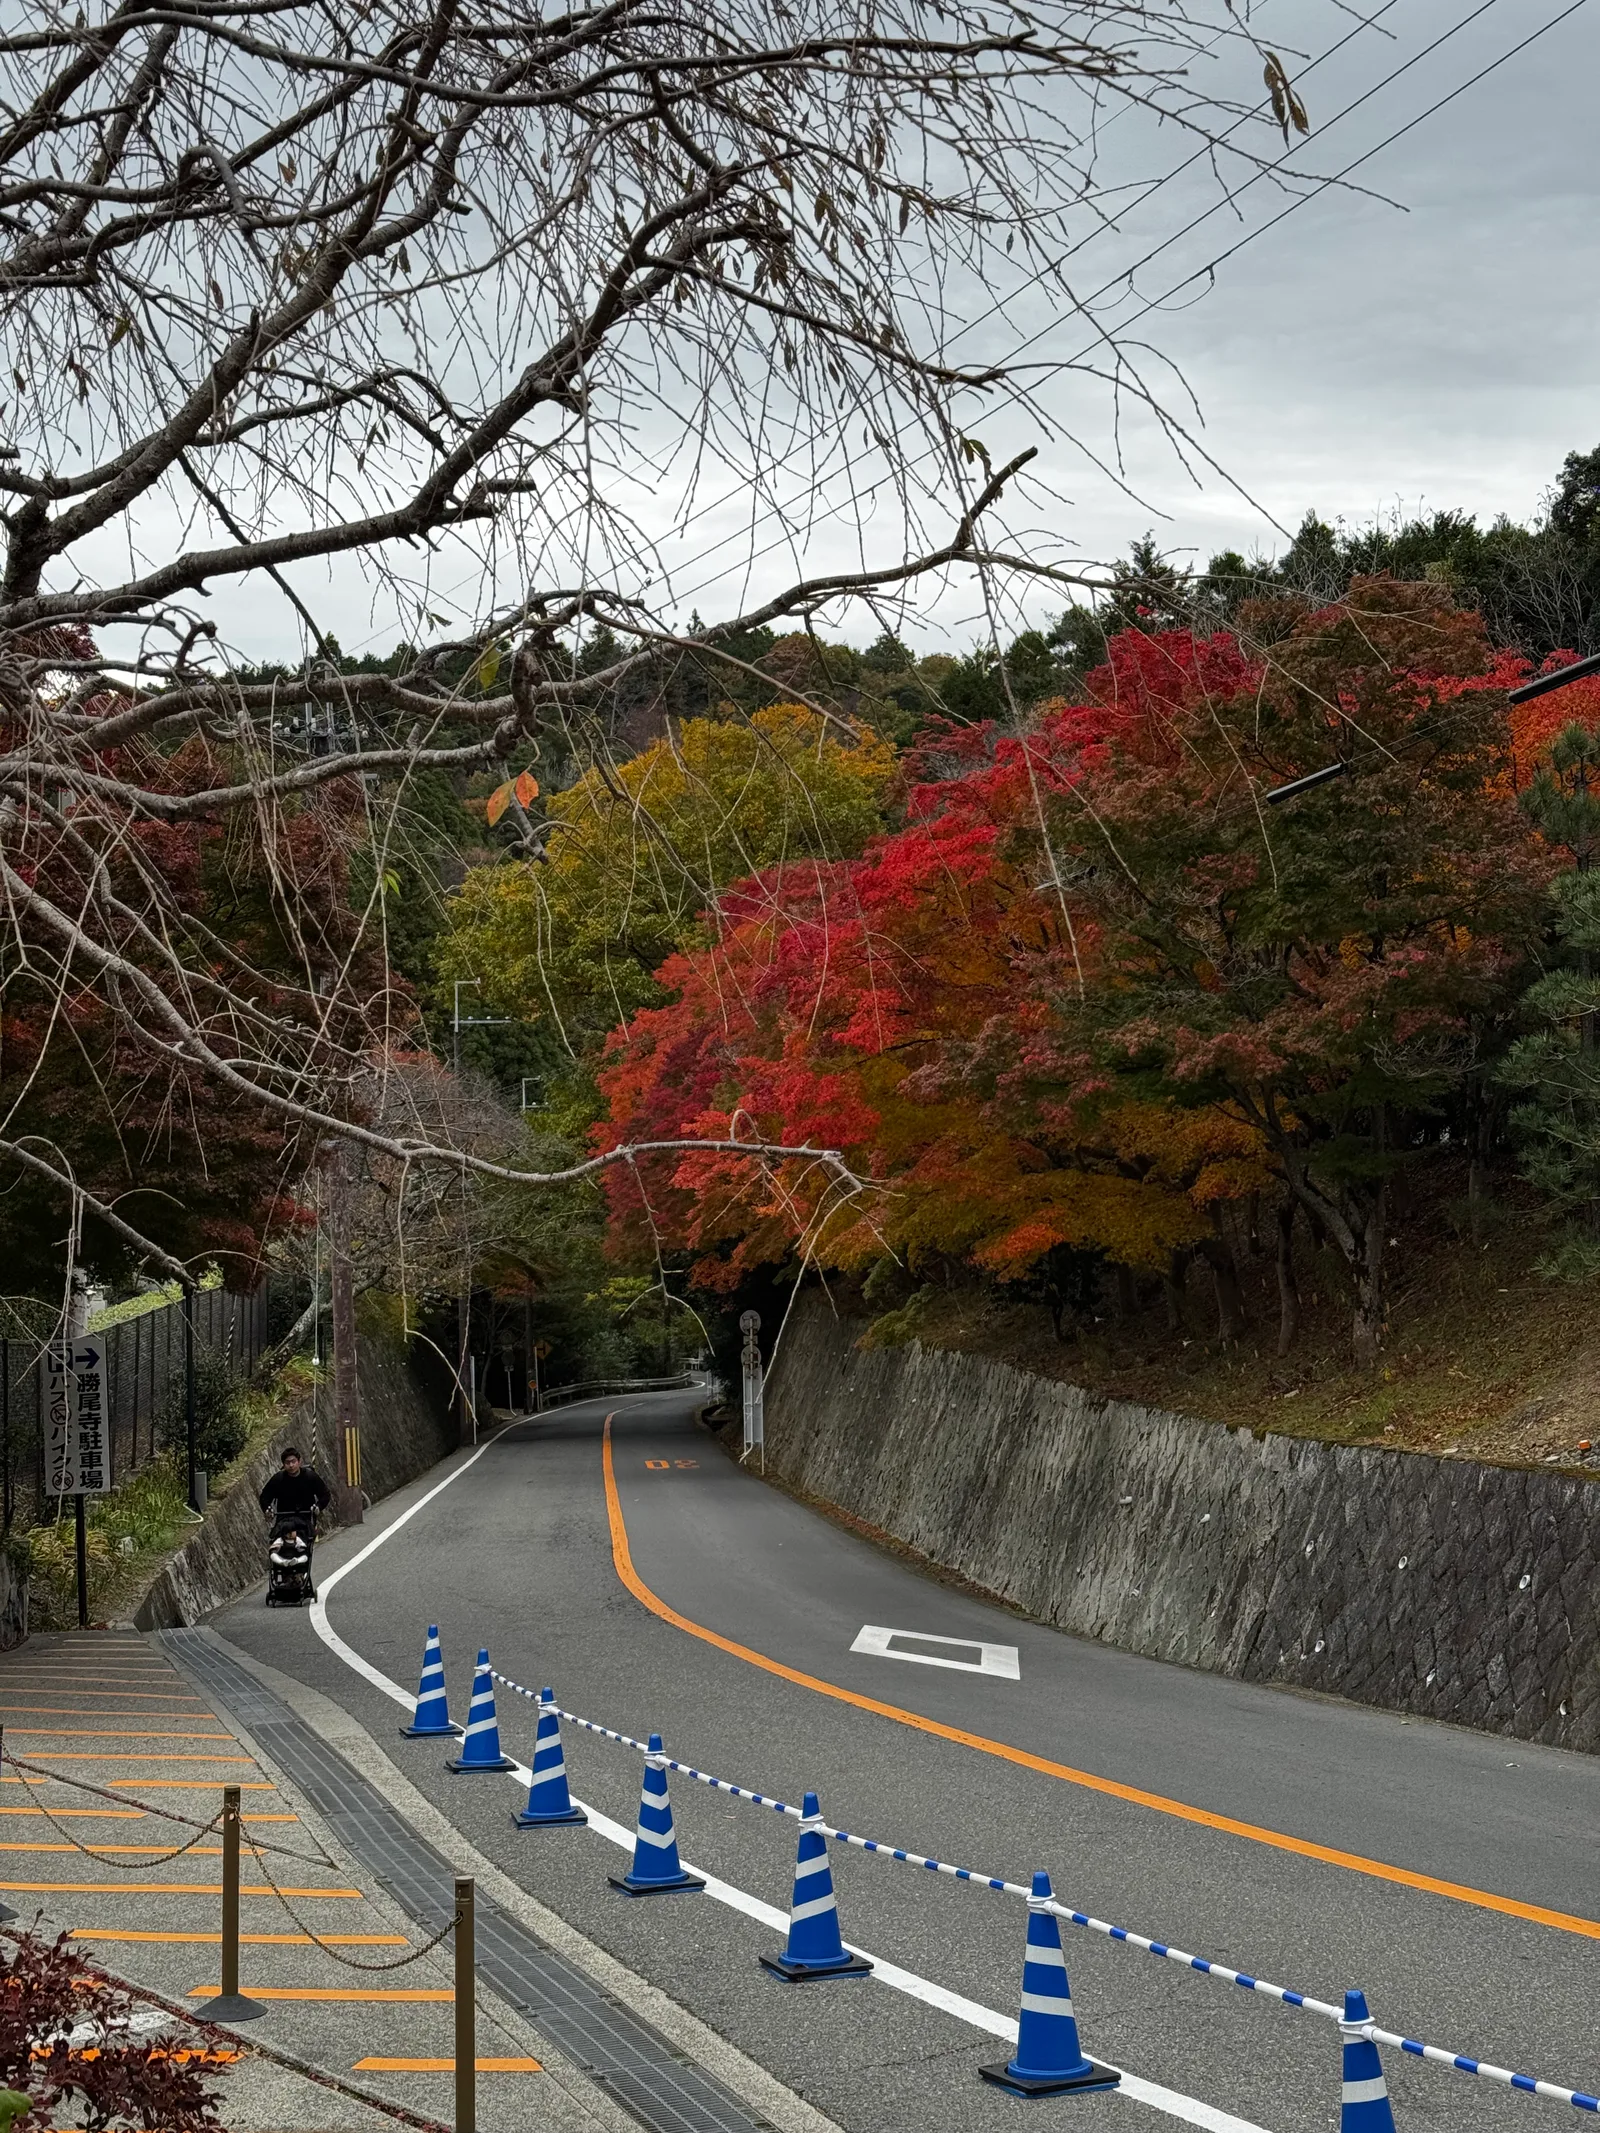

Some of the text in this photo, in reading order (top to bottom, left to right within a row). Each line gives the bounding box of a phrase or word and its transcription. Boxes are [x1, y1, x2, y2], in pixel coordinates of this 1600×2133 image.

[49, 1375, 72, 1471] バス バイク
[77, 1373, 104, 1490] 勝尾寺駐車場
